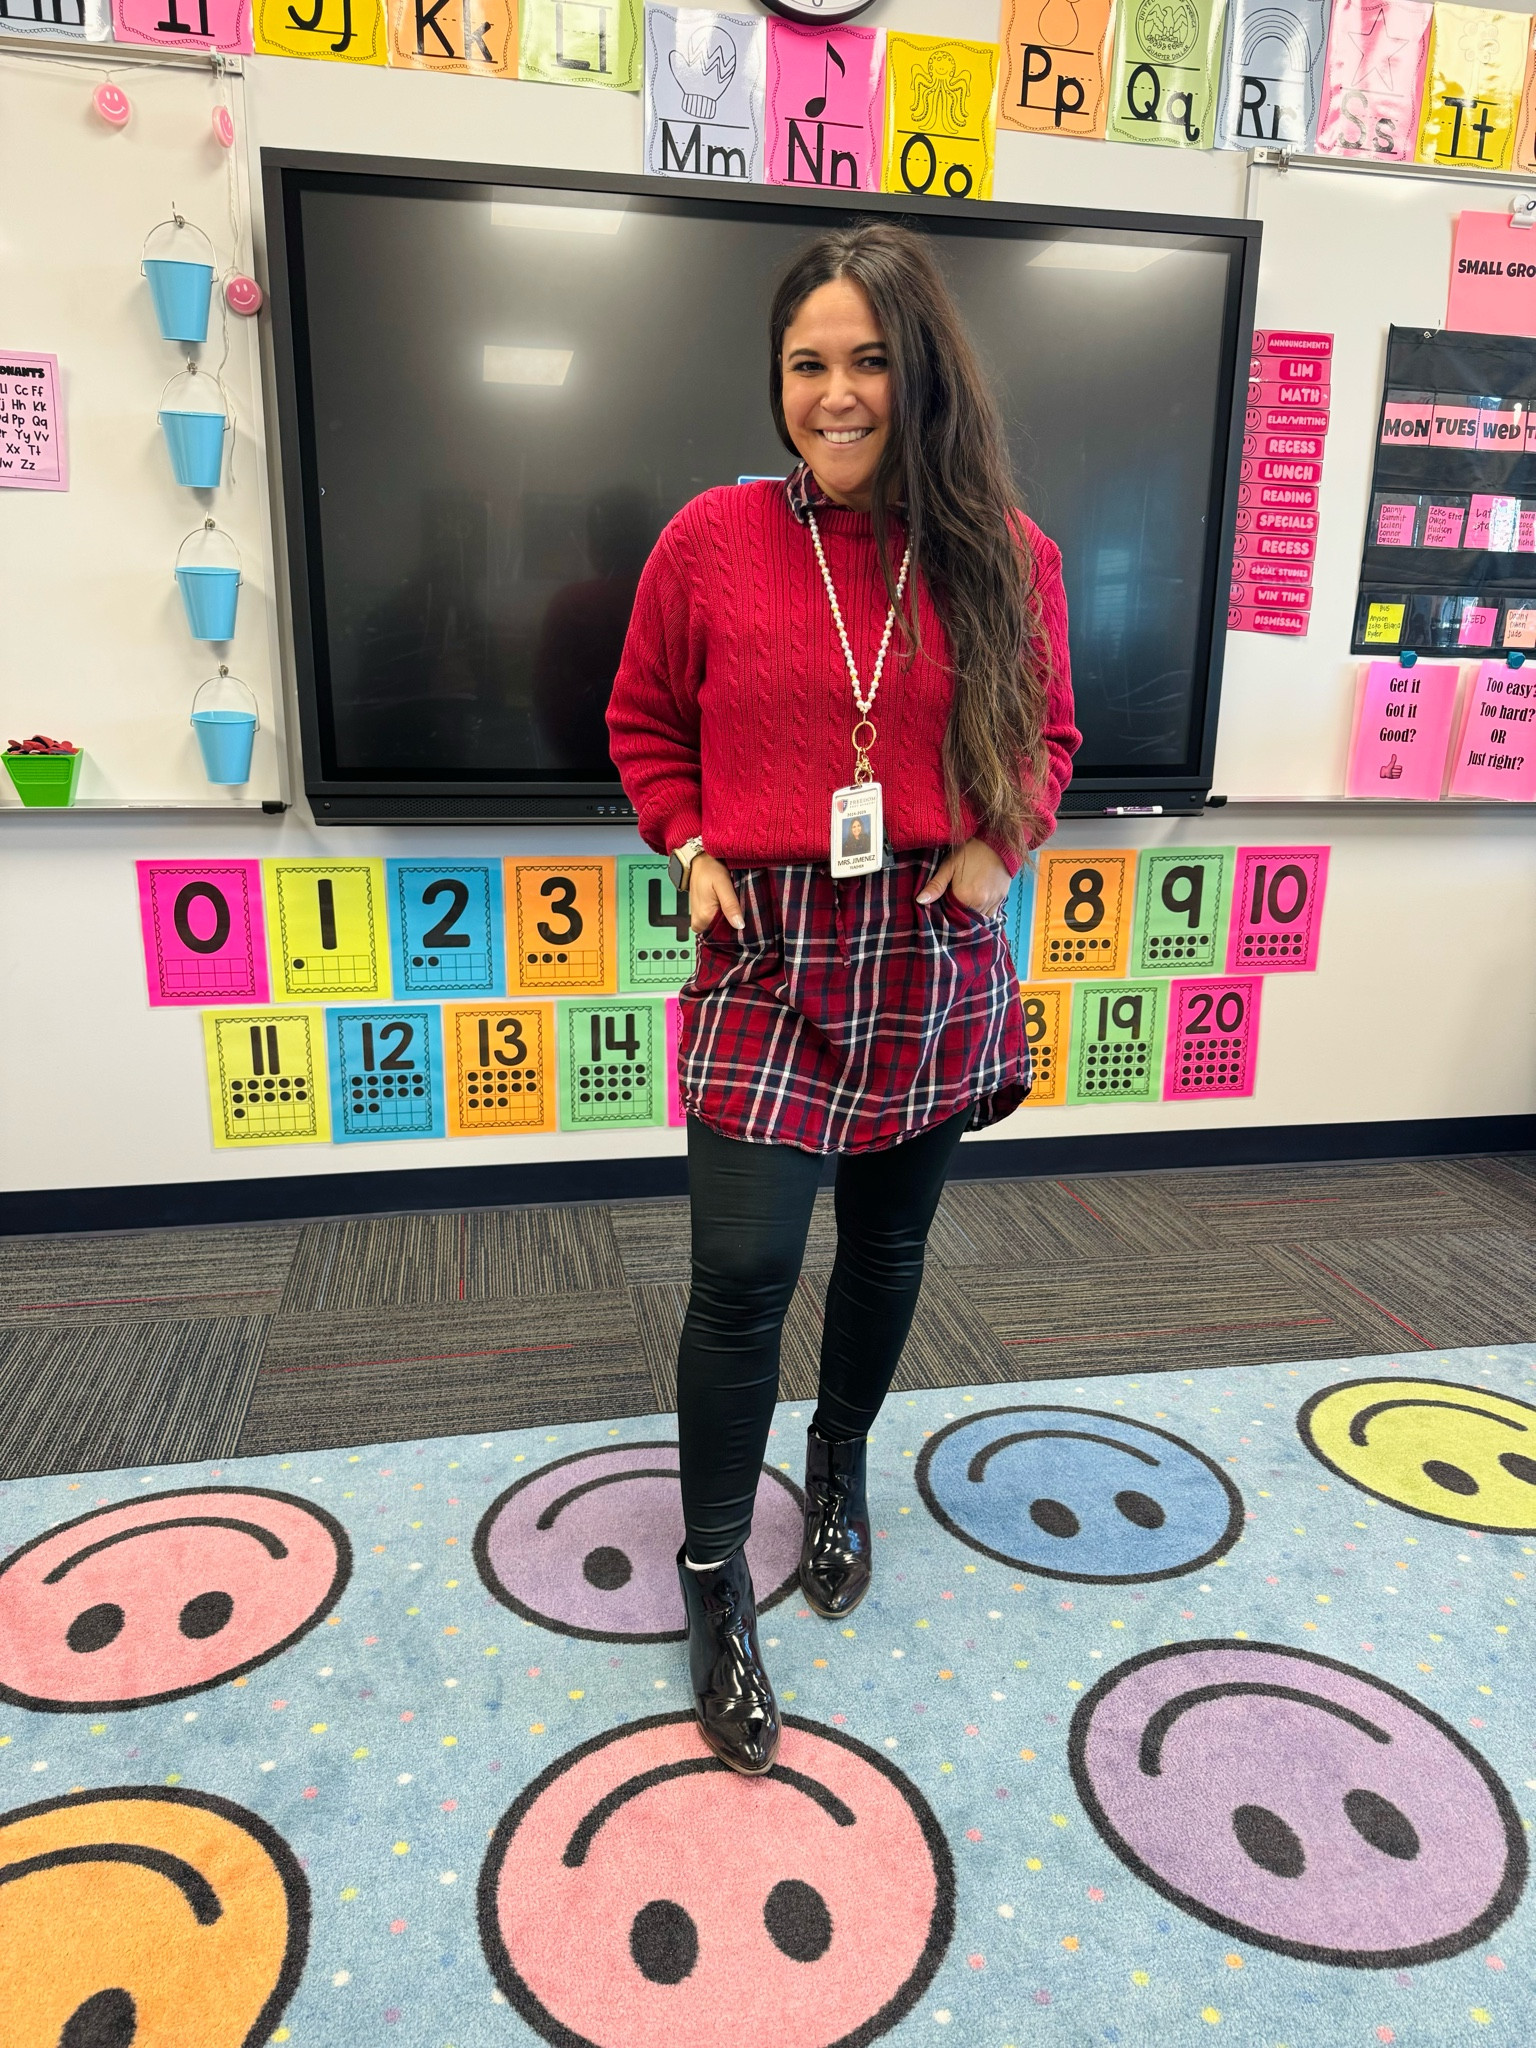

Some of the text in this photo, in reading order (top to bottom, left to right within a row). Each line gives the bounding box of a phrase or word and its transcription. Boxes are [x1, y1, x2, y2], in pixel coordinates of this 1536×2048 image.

[414, 0, 492, 62] Kk
[555, 1, 606, 73] Ll
[1022, 44, 1085, 127] Pp
[1126, 63, 1200, 143] Qq
[1236, 75, 1298, 140] Rr
[1338, 90, 1398, 153] Ss
[1444, 98, 1495, 160] Tt
[662, 119, 748, 178] Mm
[787, 118, 859, 190] Nn
[900, 133, 972, 198] Oo
[1458, 258, 1503, 276] SMALL
[1268, 339, 1330, 350] ANNOUNCEMENTS
[1289, 362, 1314, 378] LIM
[15, 384, 29, 396] Cc
[31, 385, 44, 397] Ff
[1280, 387, 1320, 403] MATH
[12, 398, 26, 410] Hh
[33, 400, 47, 412] Kk
[0, 413, 48, 430] d Pp Qq
[1267, 415, 1327, 426] ELAR/WRITING
[1383, 418, 1431, 437] MON
[1435, 417, 1477, 436] TUES
[14, 428, 31, 444] Yy
[33, 430, 50, 442] Vv
[1268, 439, 1317, 454] RECESS
[5, 442, 41, 456] Xx Tt
[0, 457, 36, 471] w Zz
[1264, 463, 1314, 481] LUNCH
[1262, 489, 1312, 504] READING
[1259, 514, 1314, 529] SPECIALS
[1261, 540, 1310, 556] RECESS
[1251, 566, 1308, 578] SOCIAL STUDIES
[1257, 589, 1306, 603] WIN TIME
[1254, 614, 1302, 629] DISMISSAL
[1389, 677, 1421, 694] Get it
[1486, 677, 1503, 694] Too
[1385, 702, 1418, 718] Got it
[1479, 701, 1536, 723] Too hard?
[1379, 727, 1417, 743] Good?
[1490, 728, 1507, 744] OR
[1466, 750, 1525, 771] Just right?
[1063, 868, 1105, 933] 8
[1161, 864, 1205, 929] 9
[1250, 864, 1308, 924] 10
[173, 881, 231, 954] 0
[317, 878, 338, 951] 1
[421, 878, 471, 948] 2
[536, 876, 584, 945] 3
[648, 878, 692, 942] 4
[1097, 994, 1143, 1041] 19
[1185, 991, 1245, 1035] 20
[361, 1021, 415, 1072] 12
[477, 1018, 528, 1067] 13
[589, 1013, 641, 1062] 14
[249, 1025, 281, 1076] 11
